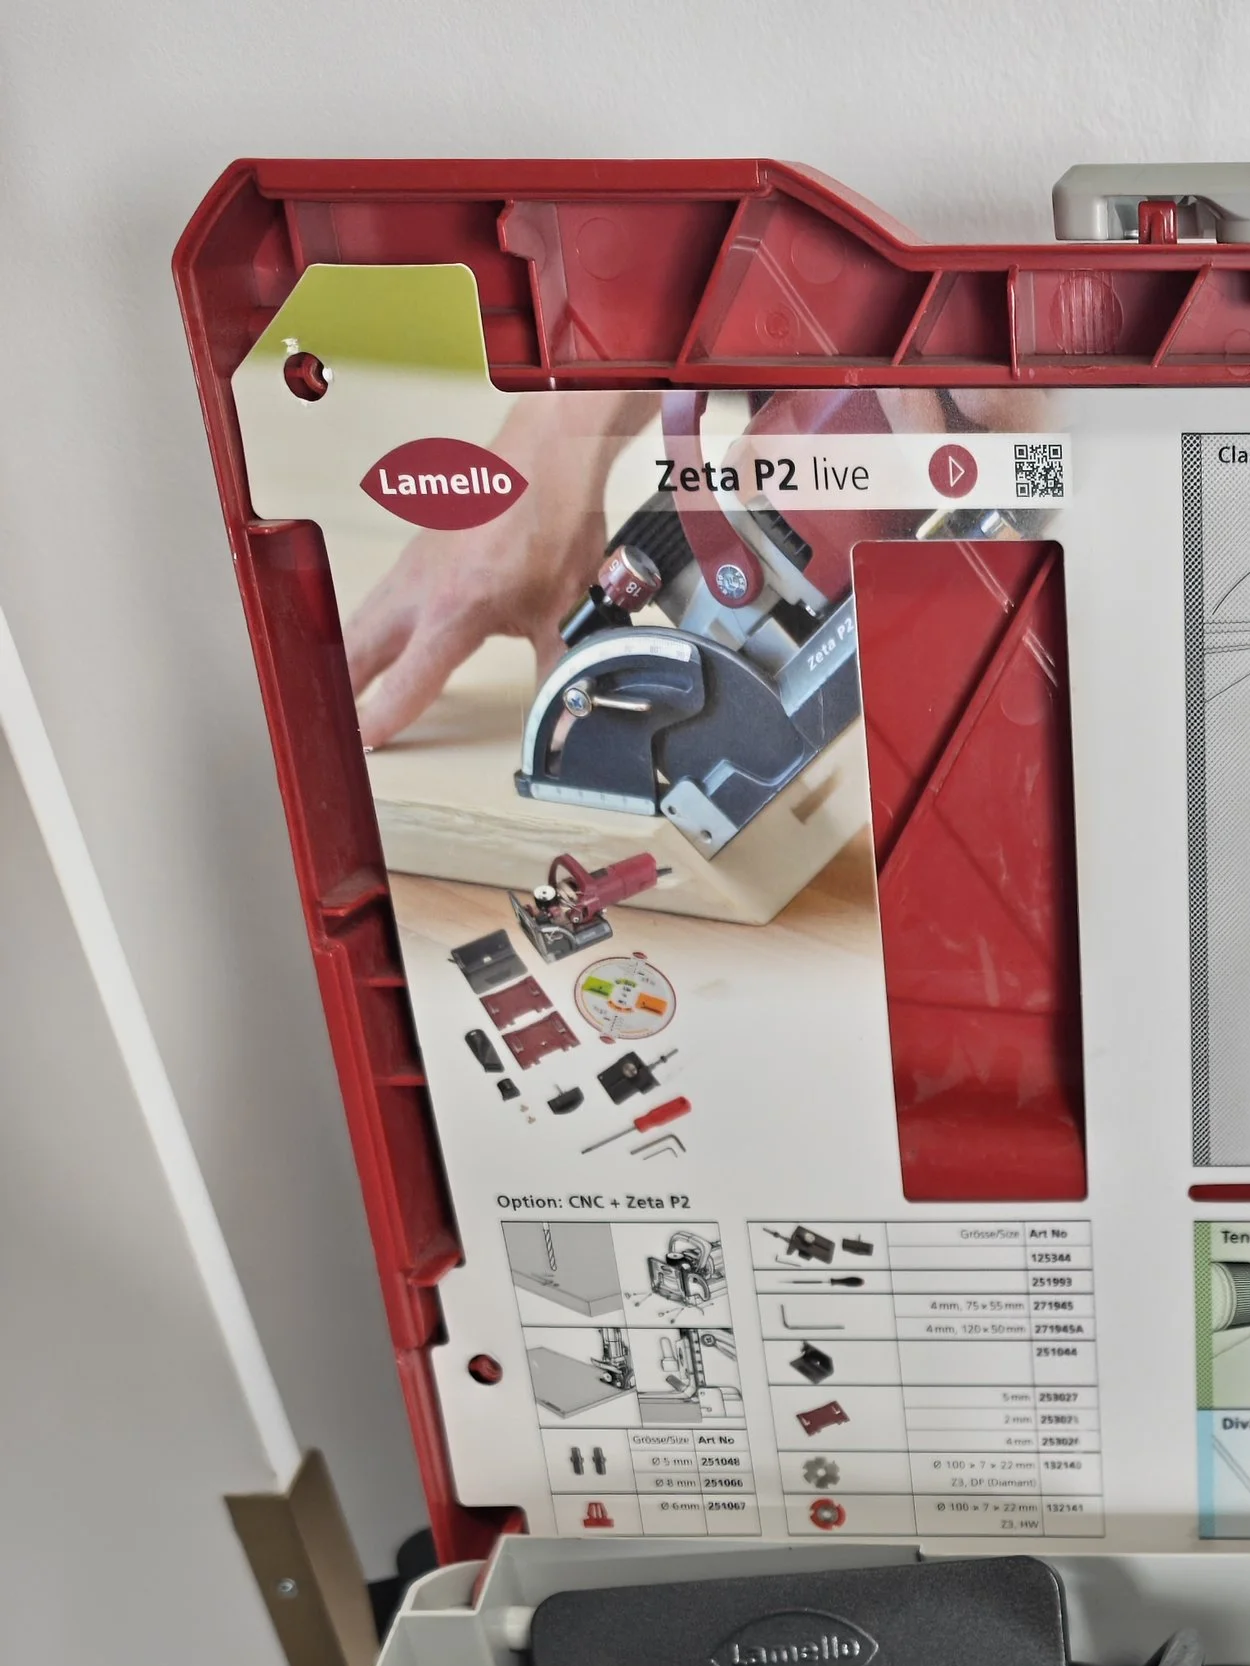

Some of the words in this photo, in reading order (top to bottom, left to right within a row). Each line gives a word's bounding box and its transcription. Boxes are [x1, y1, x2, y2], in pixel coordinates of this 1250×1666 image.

[378, 466, 512, 497] Lamello
[654, 459, 740, 492] Zeta
[754, 459, 799, 492] P2
[813, 457, 870, 491] live
[807, 639, 837, 671] Zeta
[837, 617, 855, 640] P2
[497, 1195, 564, 1211] Option:
[568, 1195, 604, 1209] CNC
[626, 1195, 665, 1209] Zeta
[671, 1195, 691, 1209] P2
[1029, 1229, 1047, 1240] Art
[1050, 1229, 1068, 1239] No
